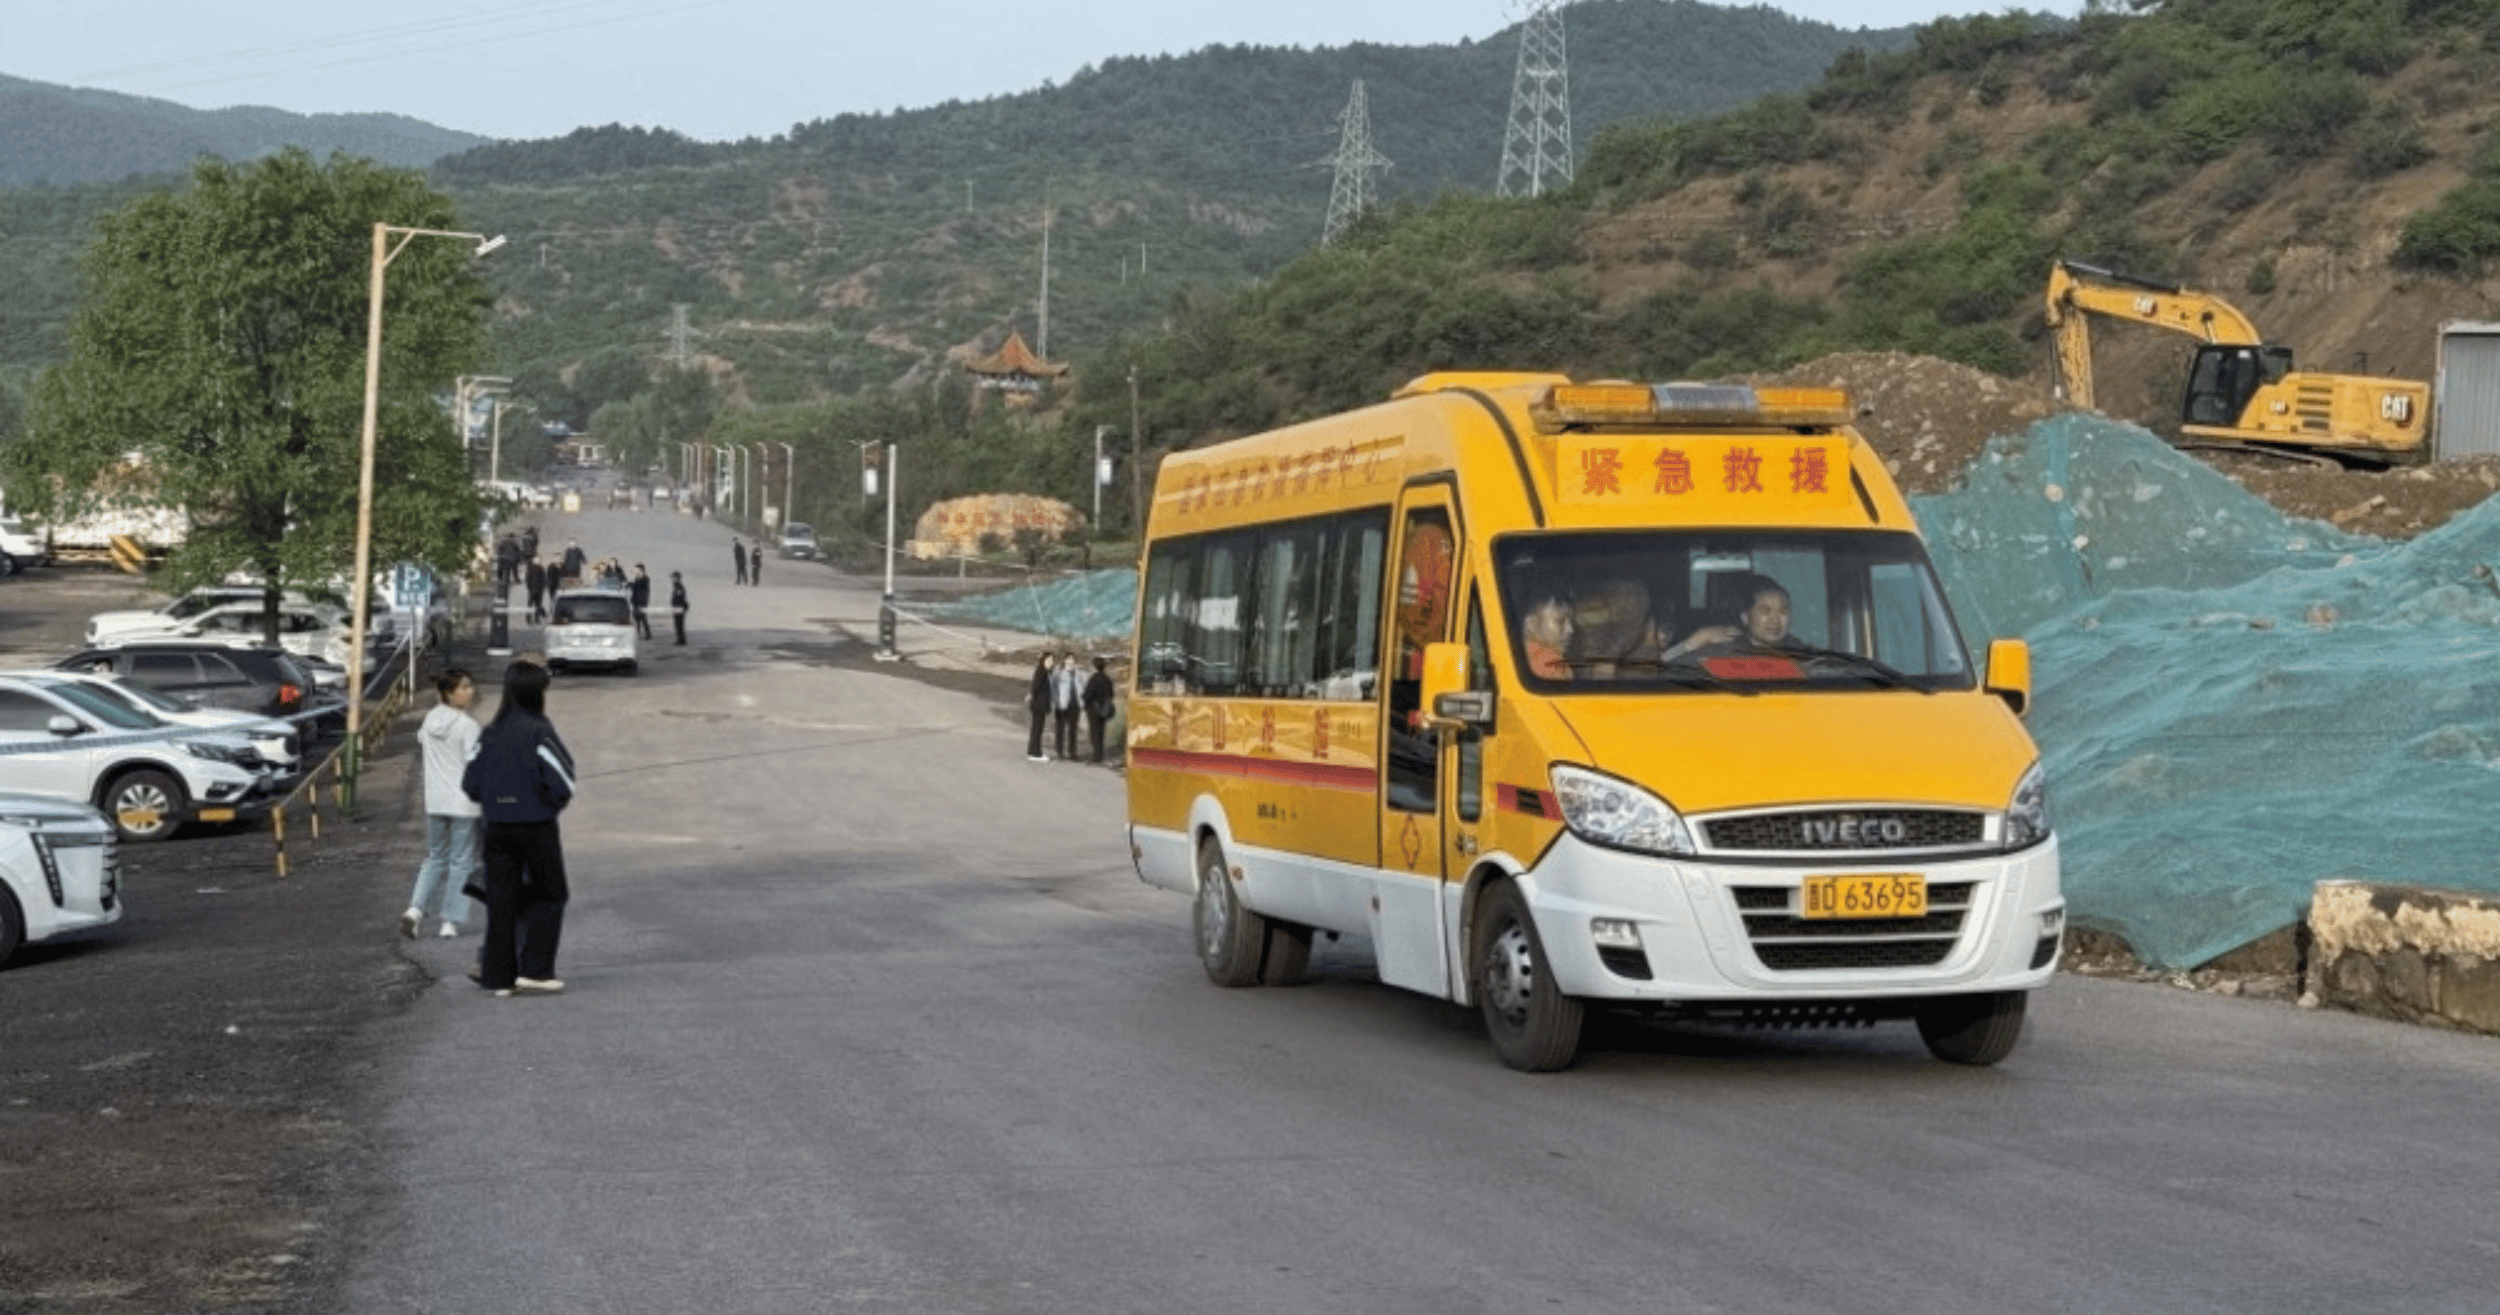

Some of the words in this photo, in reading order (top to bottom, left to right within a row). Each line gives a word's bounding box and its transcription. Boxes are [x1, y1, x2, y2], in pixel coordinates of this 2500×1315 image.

[2132, 295, 2155, 314] CAT
[2381, 394, 2409, 421] CAT
[1581, 446, 1830, 496] 紧急救援
[404, 566, 421, 591] P
[1802, 818, 1906, 843] IVECO
